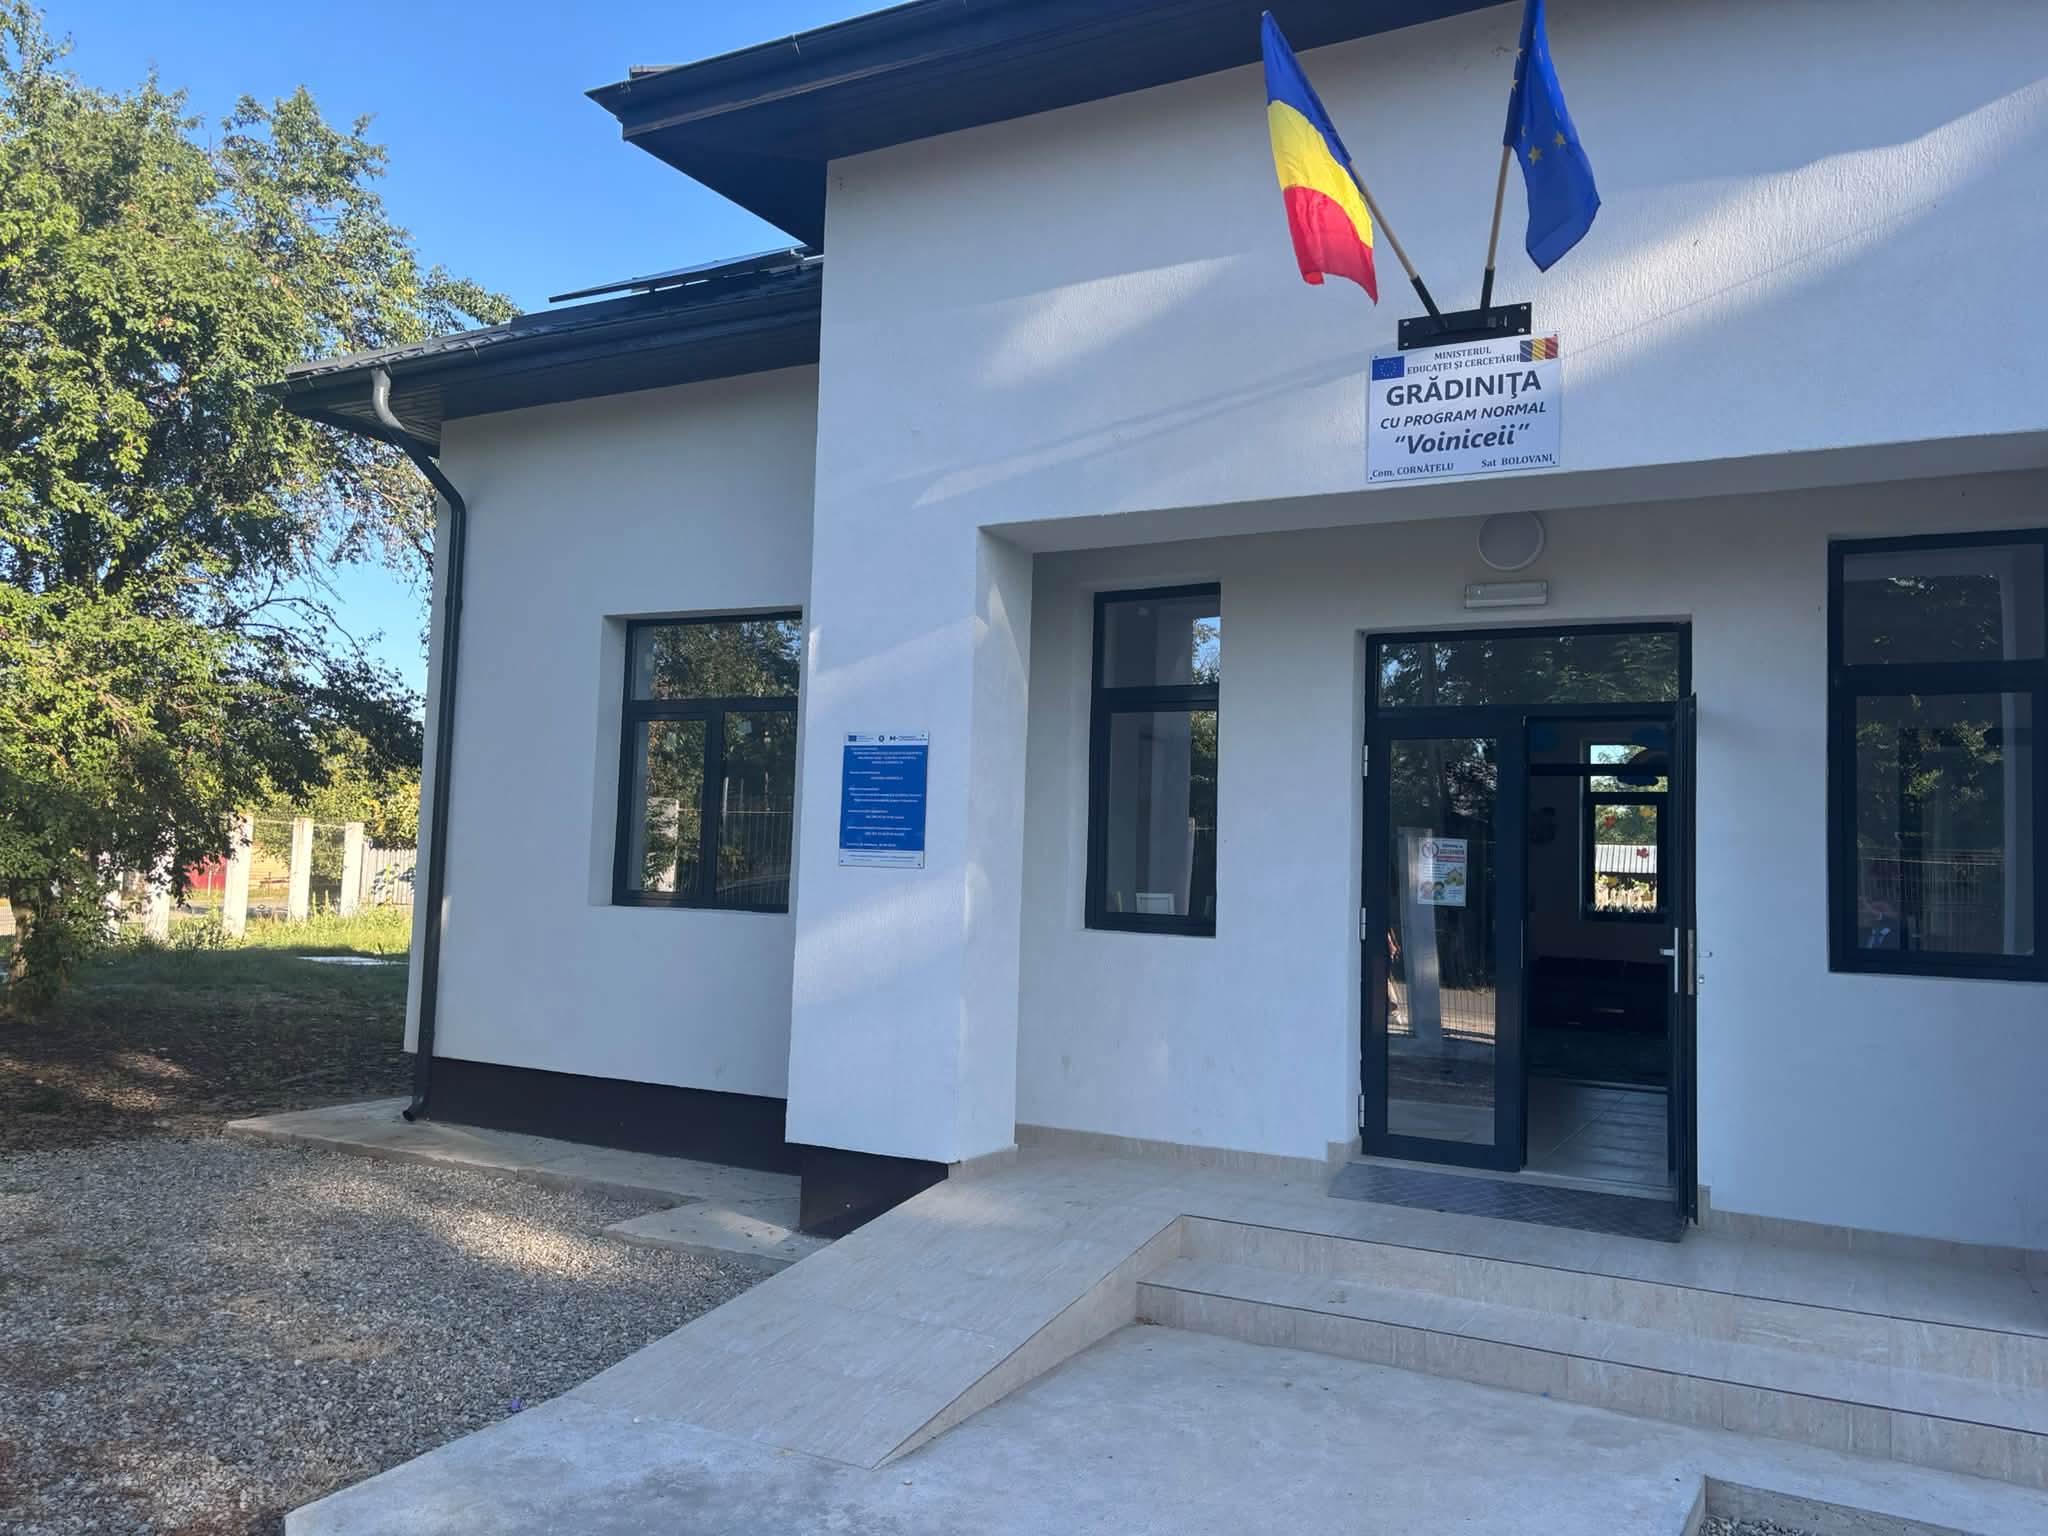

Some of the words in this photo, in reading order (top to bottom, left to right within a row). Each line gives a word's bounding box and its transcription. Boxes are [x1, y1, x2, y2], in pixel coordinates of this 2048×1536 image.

[1434, 346, 1492, 361] MINISTERUL
[1380, 417, 1400, 430] CU
[1404, 409, 1477, 427] PROGRAM
[1480, 401, 1546, 420] NORMAL
[1481, 459, 1496, 468] Sat
[1501, 453, 1553, 466] BOLOVANI
